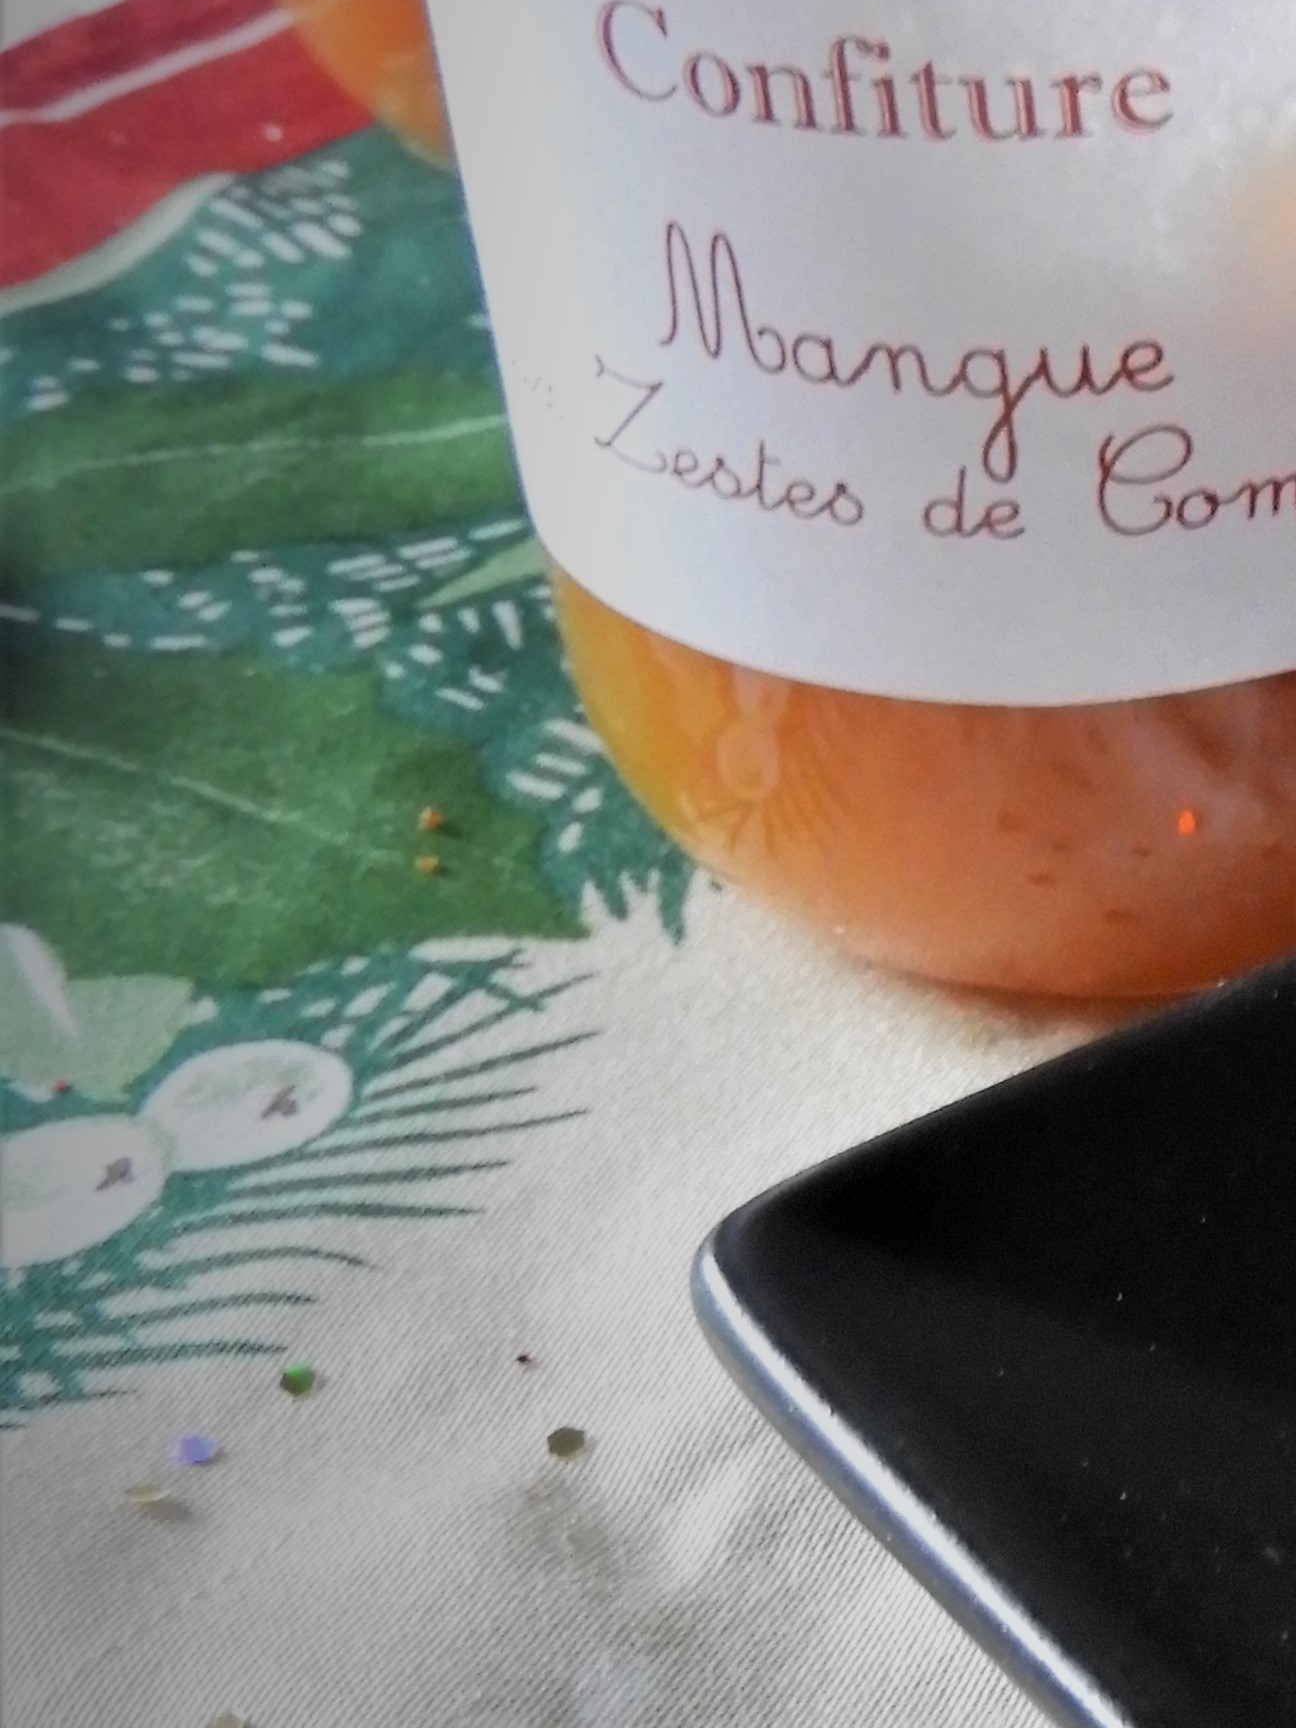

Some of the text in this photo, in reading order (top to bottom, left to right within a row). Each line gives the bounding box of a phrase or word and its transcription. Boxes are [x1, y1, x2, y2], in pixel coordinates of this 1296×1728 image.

[592, 354, 866, 528] Zestes
[922, 466, 1026, 542] de
[660, 220, 1175, 482] Mangue
